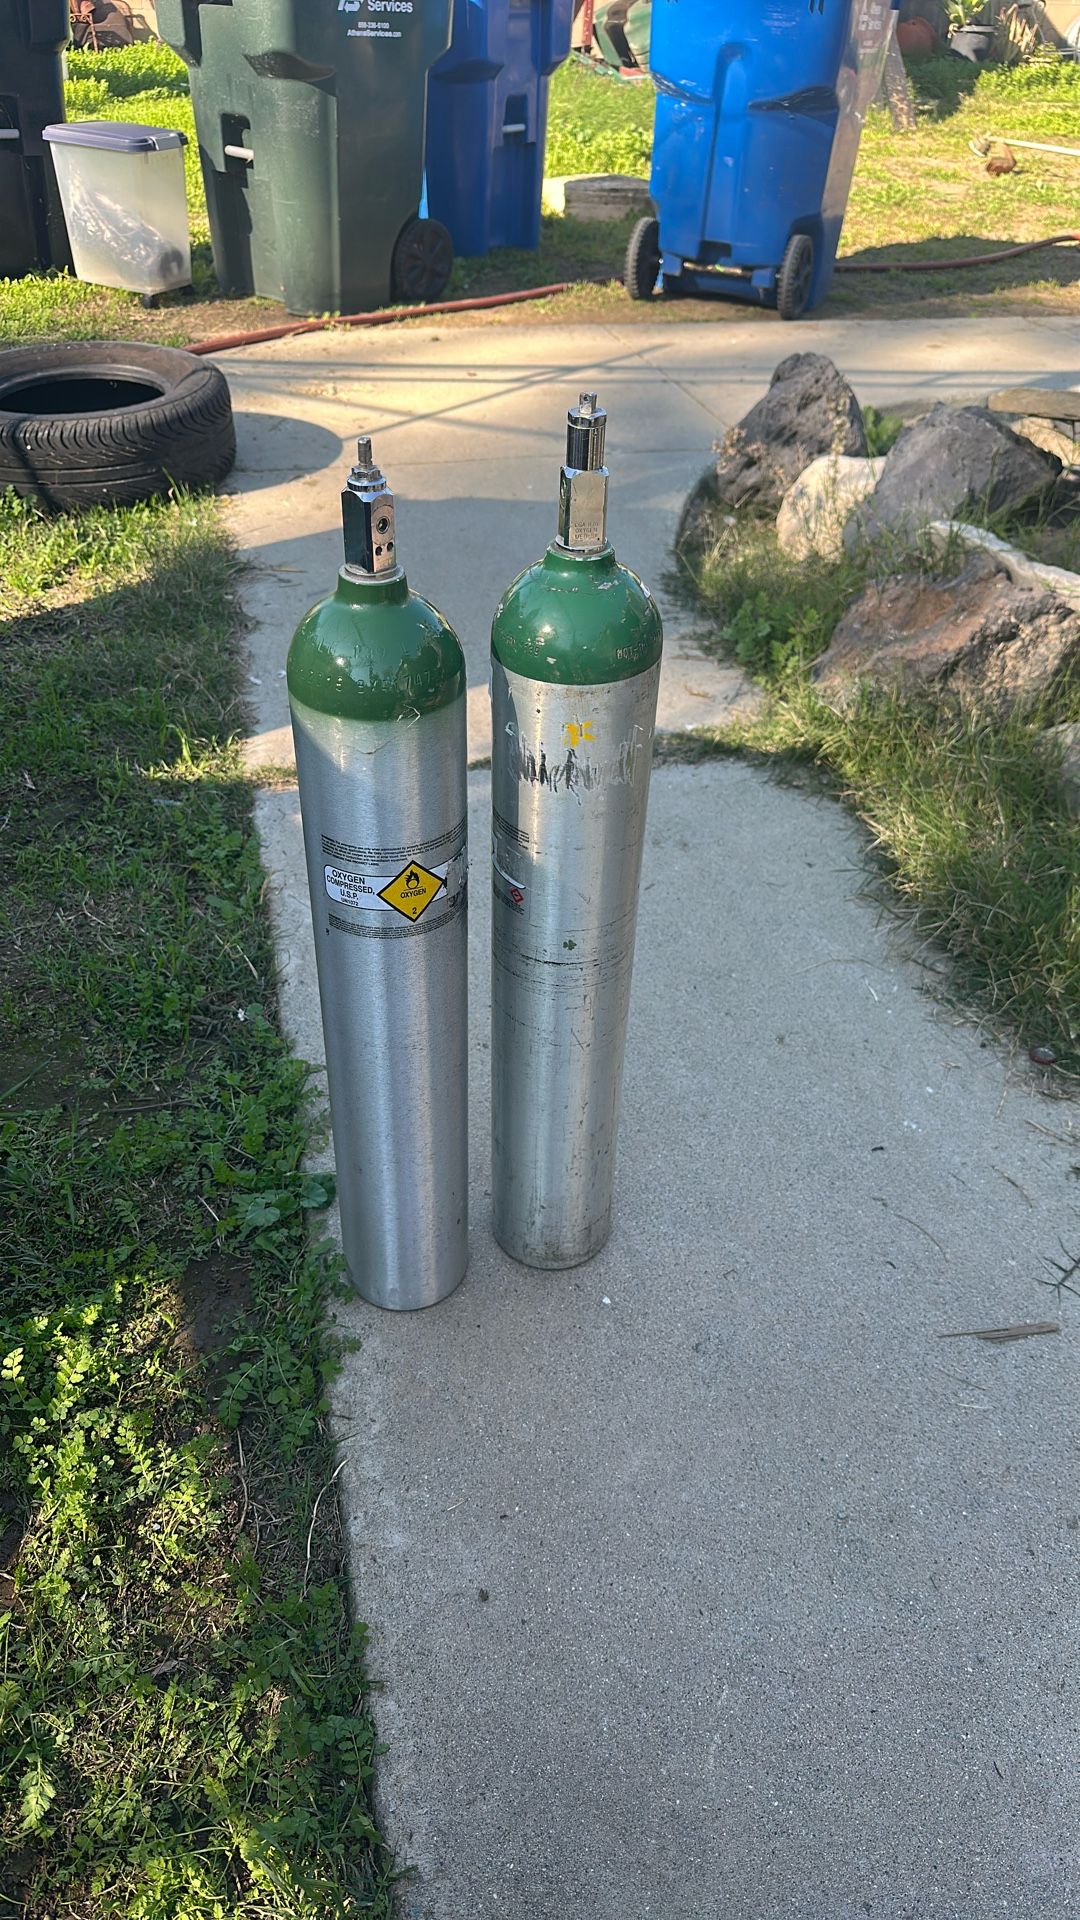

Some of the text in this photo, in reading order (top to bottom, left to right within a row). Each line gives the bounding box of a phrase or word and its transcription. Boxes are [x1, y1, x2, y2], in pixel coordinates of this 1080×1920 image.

[367, 0, 413, 13] Services
[332, 869, 365, 885] OXYGEN
[326, 875, 375, 895] COMPRESSED,
[340, 888, 359, 900] U.S.P.
[400, 887, 427, 899] OXYGEN
[412, 906, 418, 915] 2
